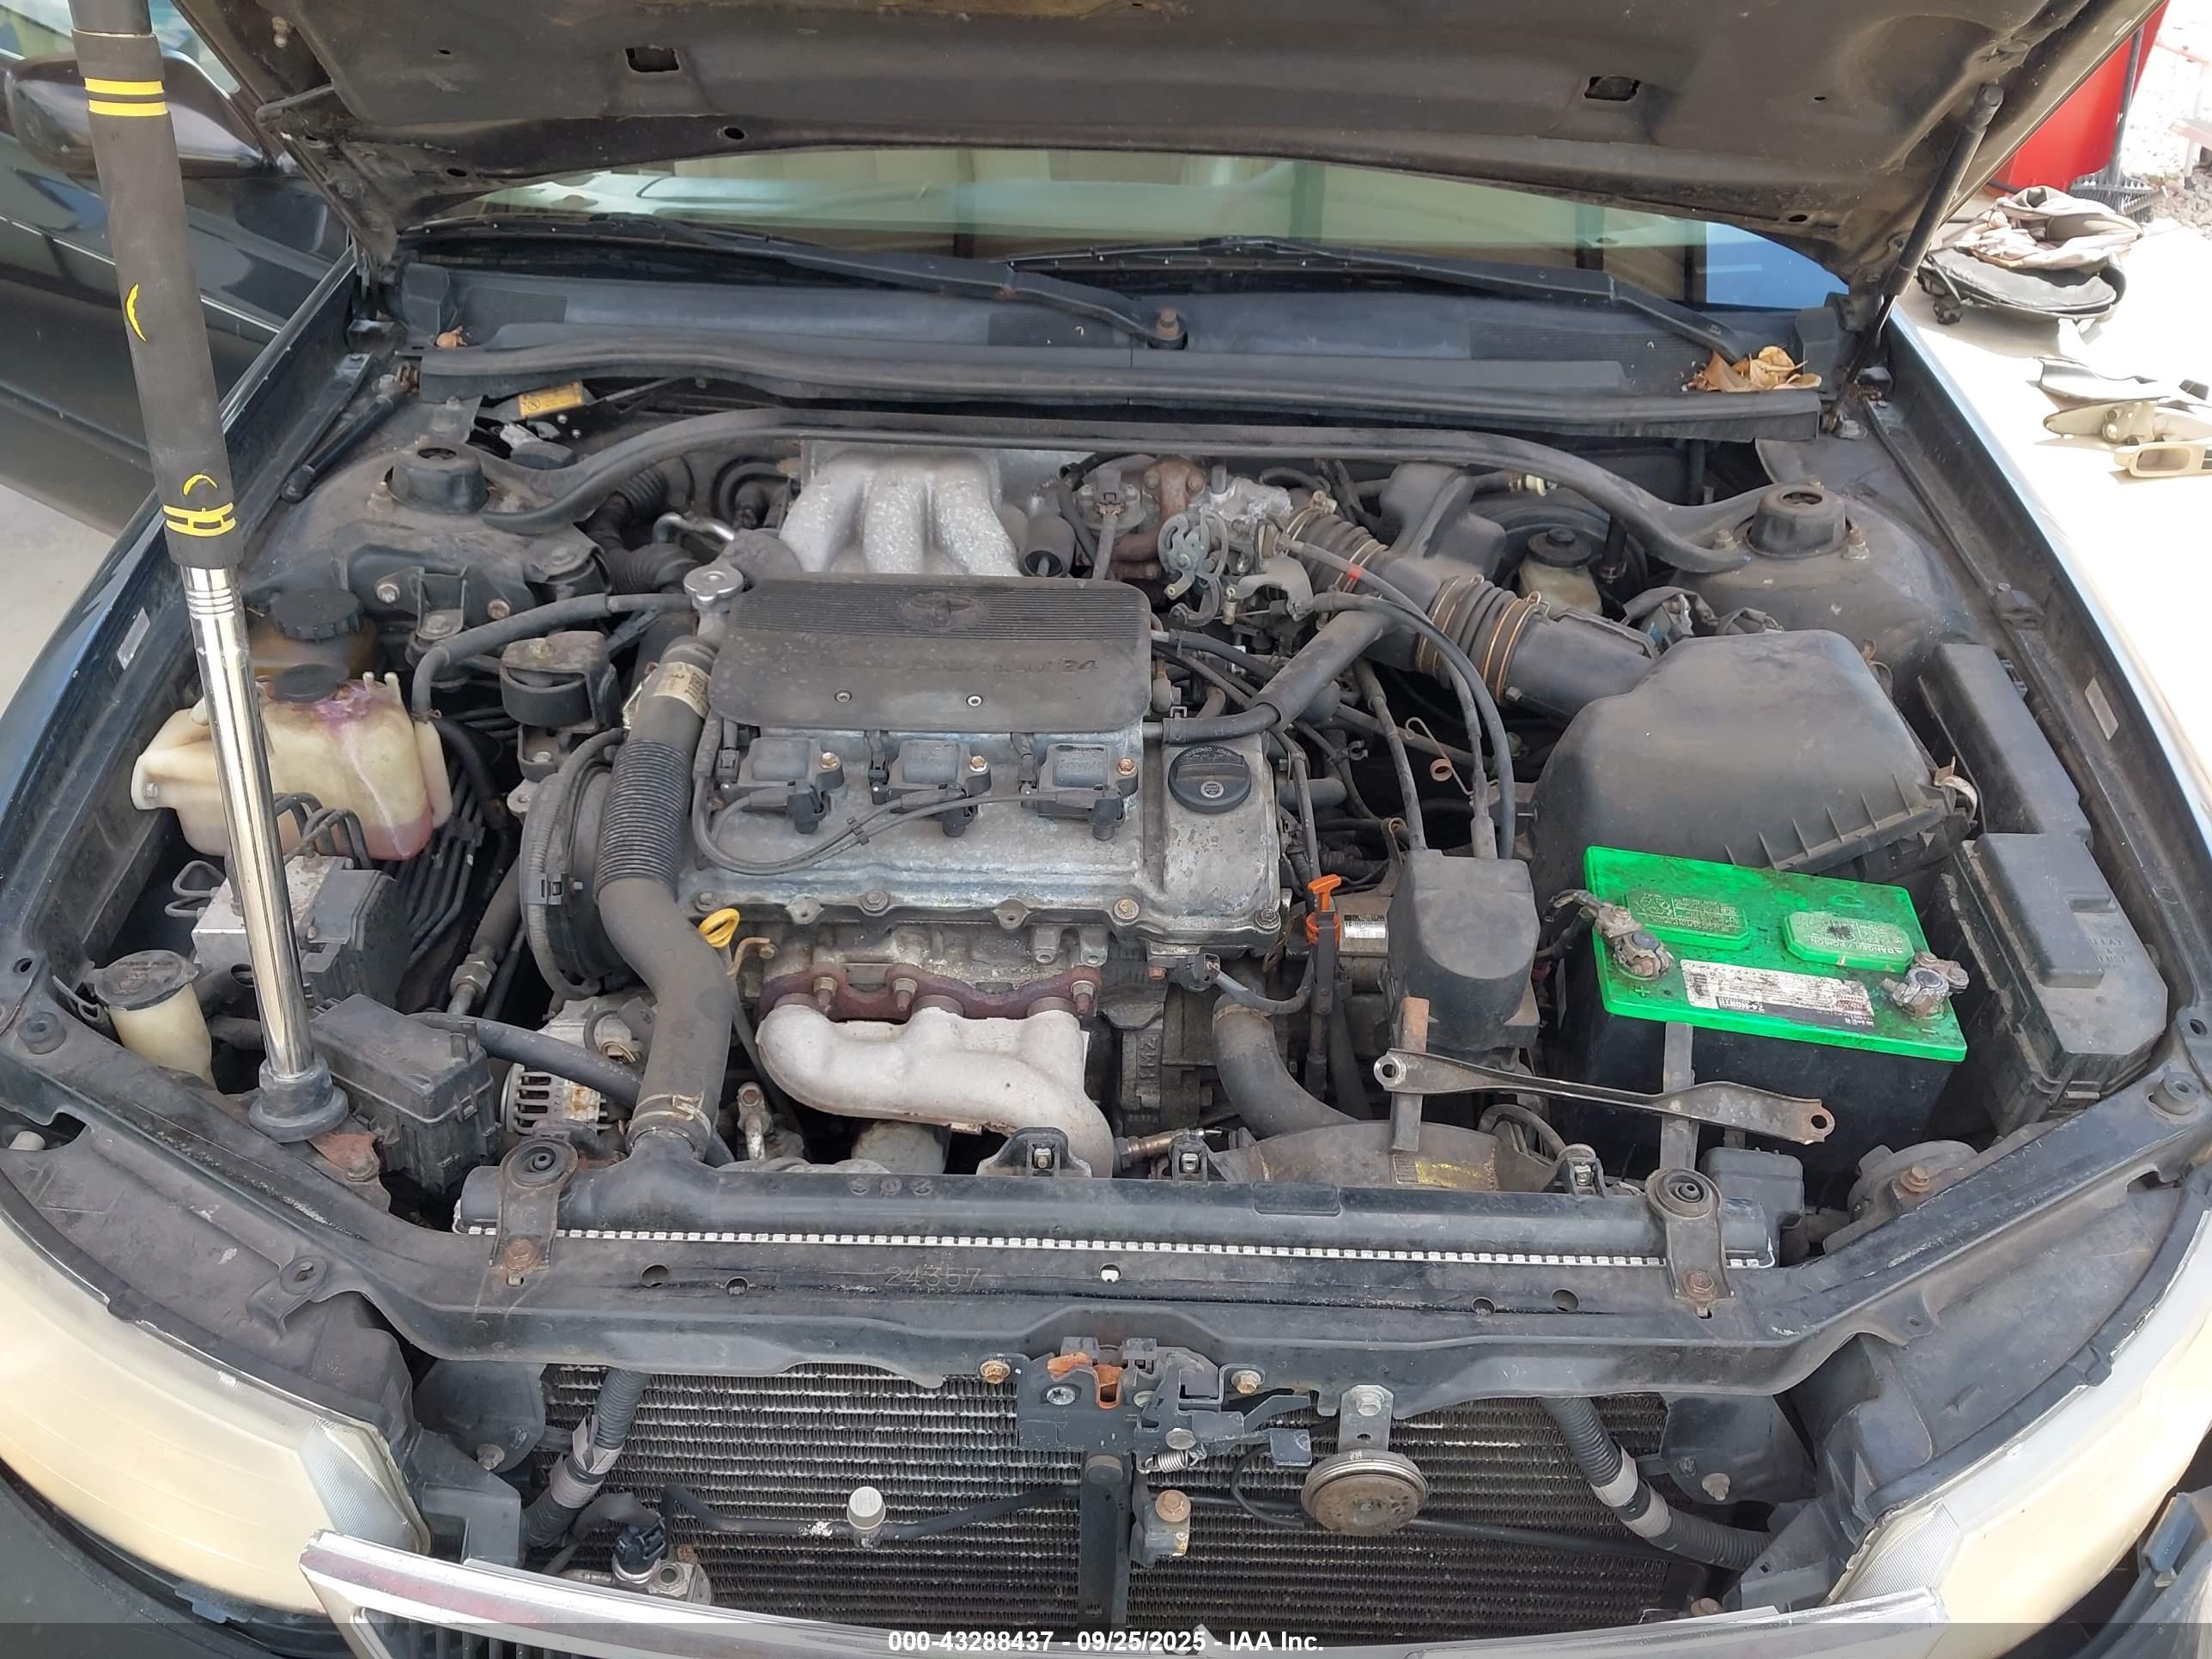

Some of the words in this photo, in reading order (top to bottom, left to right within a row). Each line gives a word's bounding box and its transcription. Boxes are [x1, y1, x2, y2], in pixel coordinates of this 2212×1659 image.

[1059, 658, 1098, 674] 24
[1810, 938, 1845, 947] POISON
[1856, 943, 1895, 954] DANGER
[884, 1266, 981, 1288] 24357
